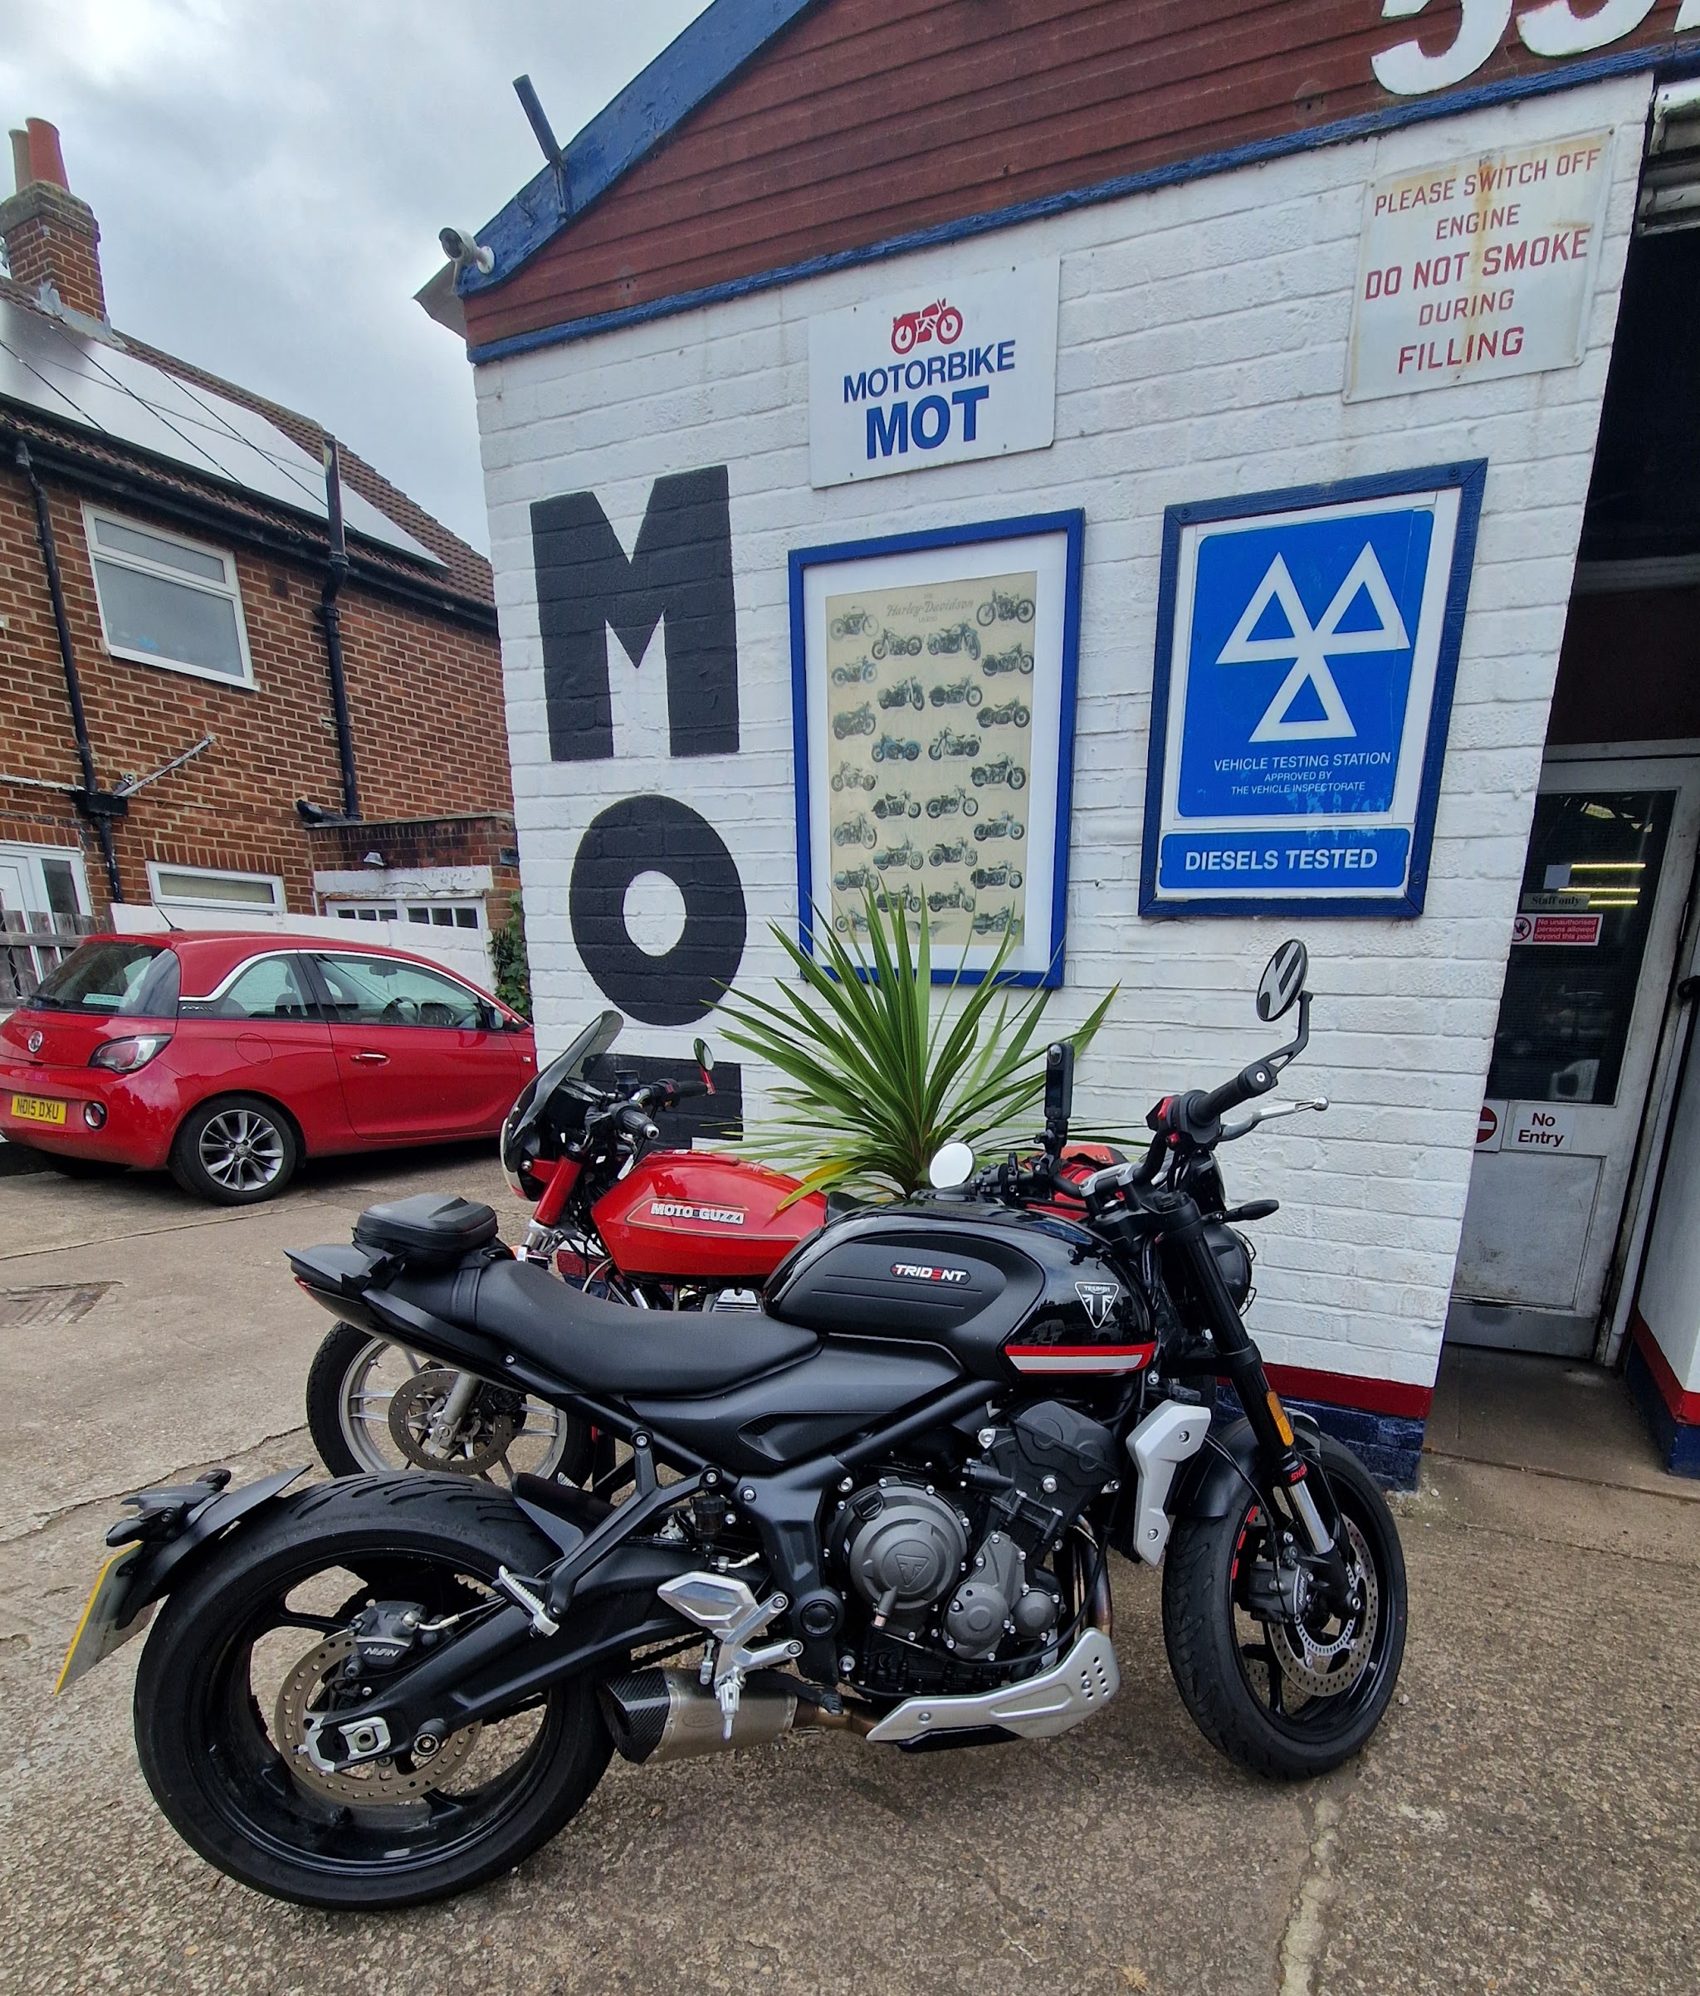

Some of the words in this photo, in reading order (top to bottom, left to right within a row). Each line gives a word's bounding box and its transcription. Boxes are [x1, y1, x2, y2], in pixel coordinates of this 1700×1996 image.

[1373, 178, 1456, 216] PLEASE
[1464, 159, 1548, 196] SWITCH
[1556, 148, 1602, 177] OFF
[1436, 204, 1521, 240] ENGINE
[1365, 266, 1401, 300] DO
[1413, 252, 1469, 291] NOT
[1482, 228, 1591, 276] SMOKE
[1419, 288, 1515, 326] DURING
[1398, 326, 1524, 374] FILLING
[843, 339, 1016, 403] MOTORBIKE
[866, 384, 990, 460] MOT
[1214, 756, 1268, 771] VEHICLE
[1272, 754, 1329, 769] TESTING
[1332, 751, 1391, 766] STATION
[1264, 771, 1317, 782] APPROVED
[1318, 770, 1332, 780] BY
[1231, 785, 1249, 795] THE
[1251, 784, 1291, 795] VEHICLE
[1292, 781, 1366, 793] INSPECTORATE
[1185, 849, 1279, 871] DIESELS
[1285, 848, 1378, 869] TESTED
[1531, 896, 1556, 905] Staff
[1558, 896, 1580, 906] only
[1534, 933, 1561, 941] beyond
[1576, 933, 1596, 941] point
[1536, 926, 1566, 934] persons
[39, 1101, 60, 1120] DXU
[1532, 1112, 1556, 1127] No
[1518, 1130, 1565, 1148] Entry
[651, 1203, 694, 1218] MOTO
[699, 1207, 745, 1225] GUZZI
[894, 1263, 967, 1282] TRIDENT
